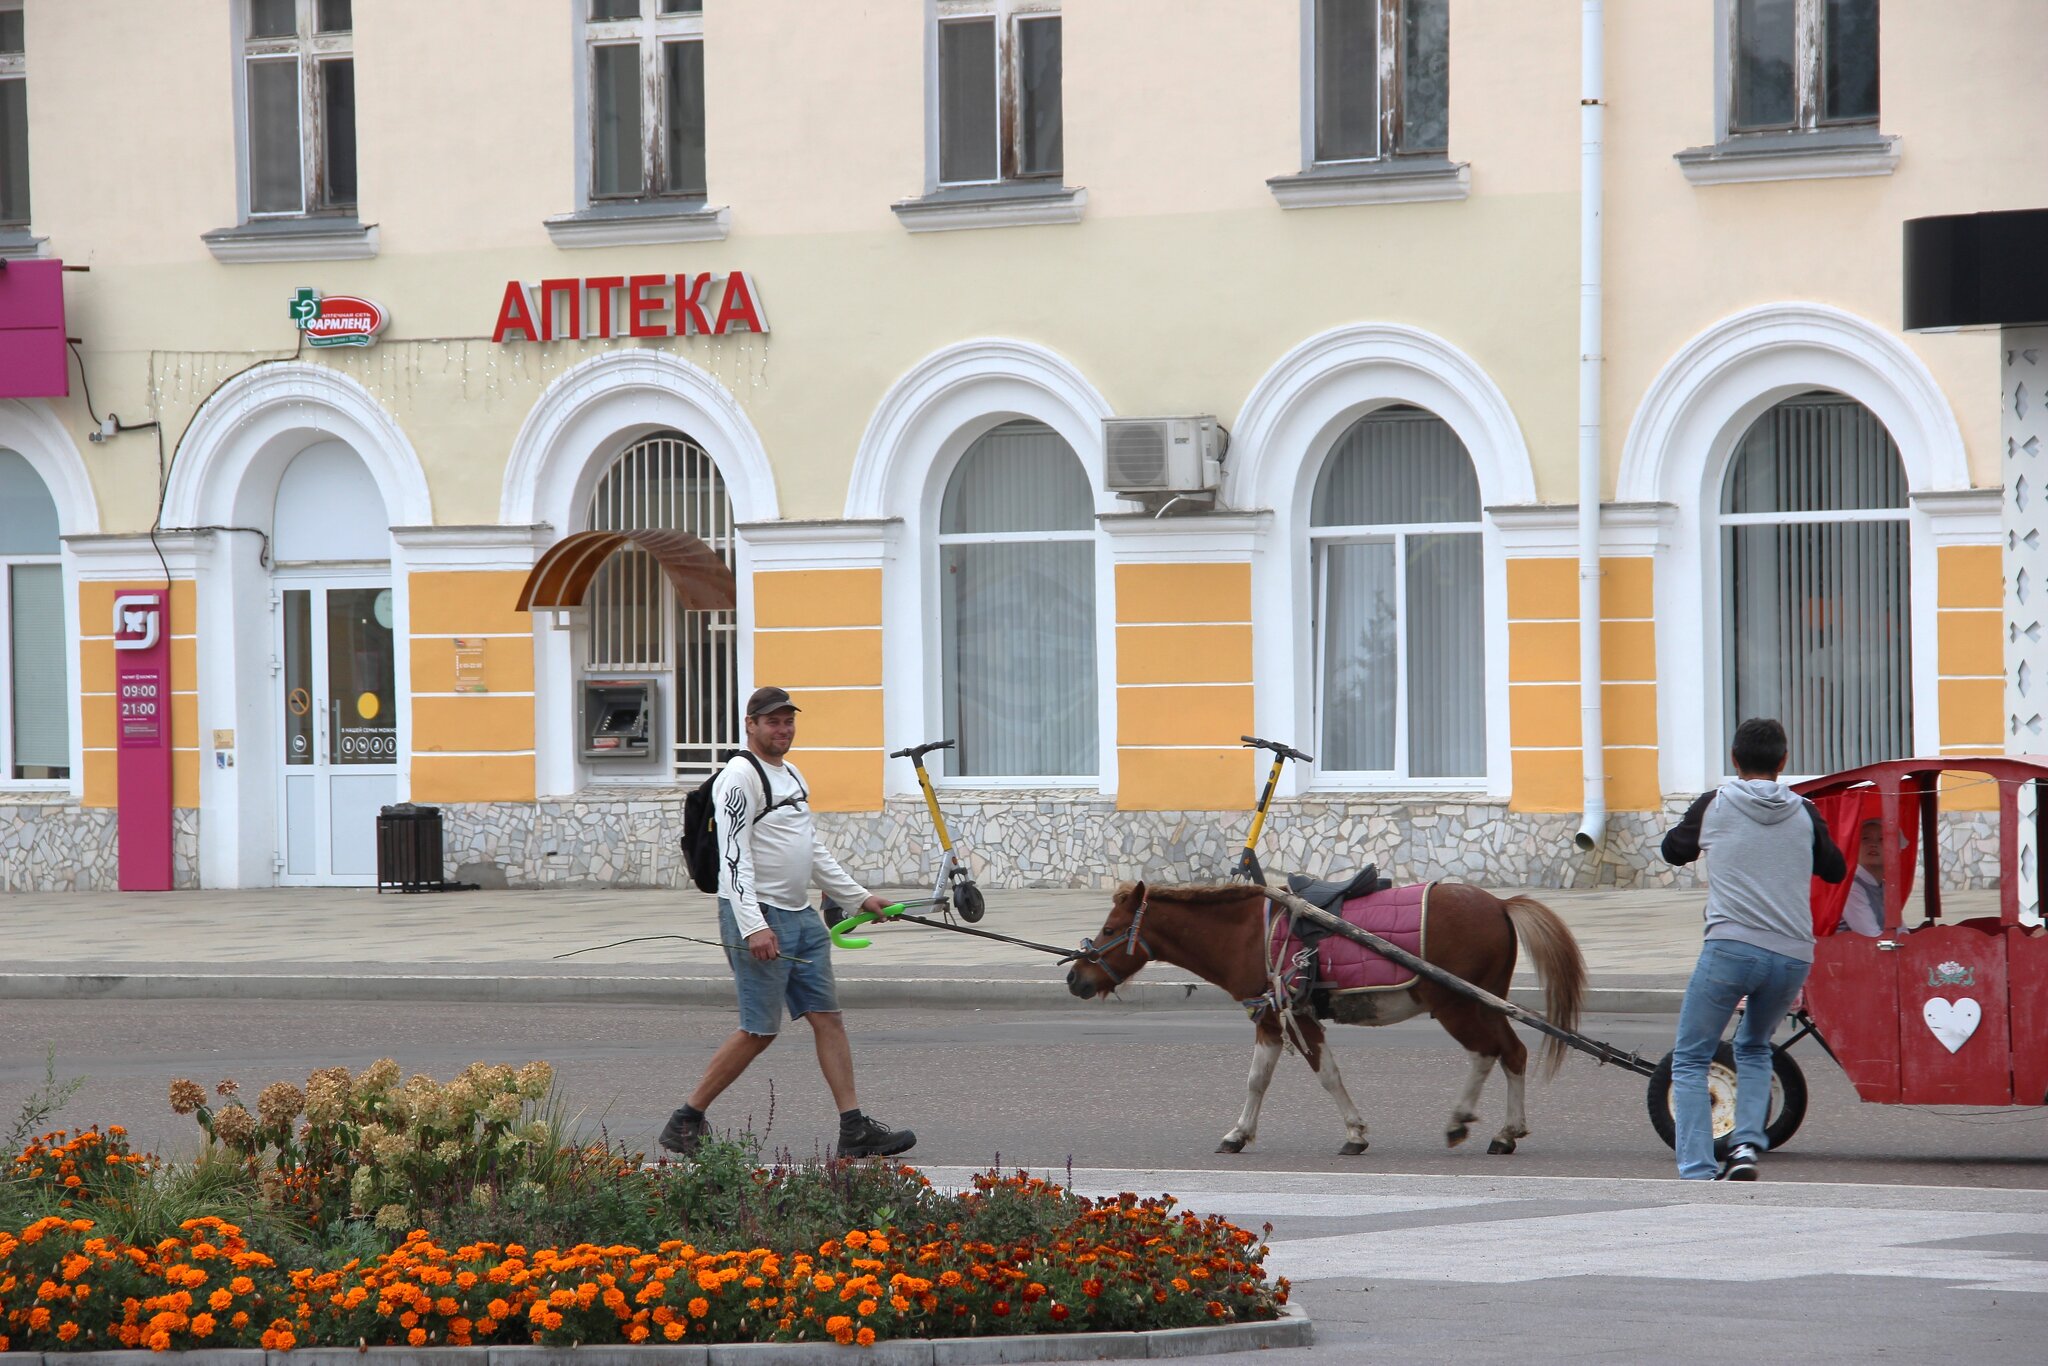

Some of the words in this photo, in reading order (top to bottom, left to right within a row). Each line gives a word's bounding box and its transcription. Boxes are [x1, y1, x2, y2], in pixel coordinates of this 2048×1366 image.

[492, 271, 765, 343] АПТЕКА
[307, 318, 371, 331] ФАРМЛЕНД
[122, 685, 157, 697] 09:00
[122, 703, 156, 715] 21:00
